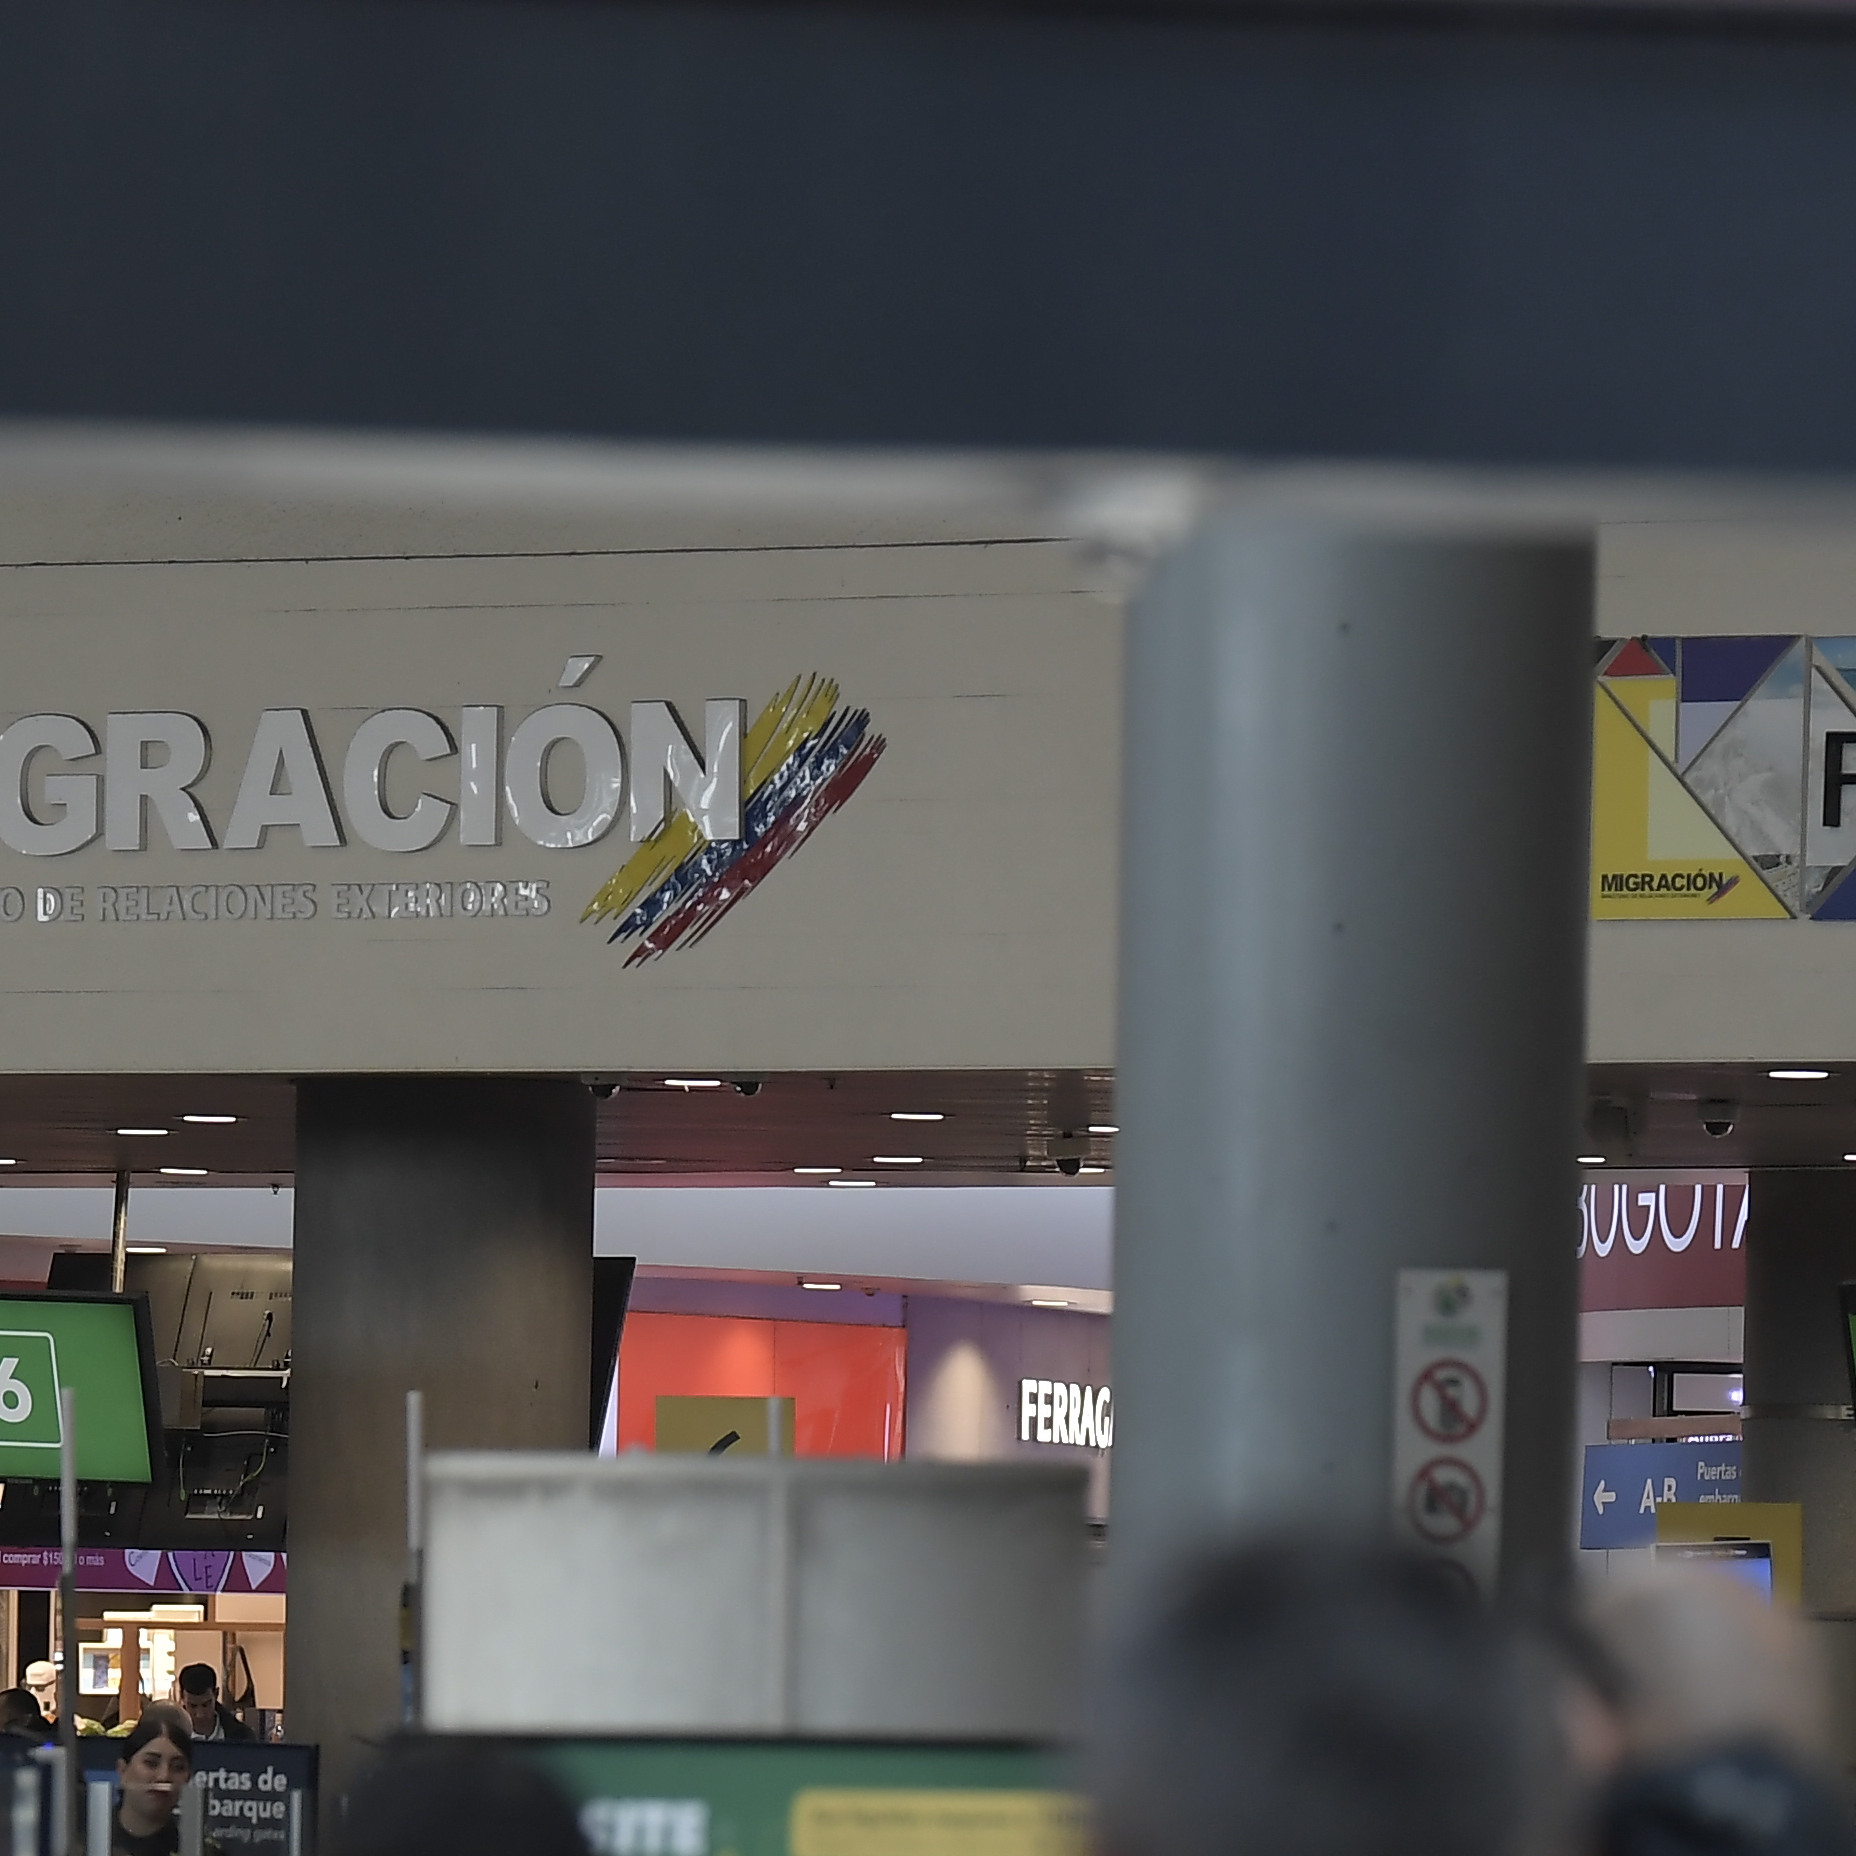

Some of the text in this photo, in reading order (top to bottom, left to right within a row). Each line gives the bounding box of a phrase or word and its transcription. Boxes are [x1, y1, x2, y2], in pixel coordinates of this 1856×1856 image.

[1600, 868, 1724, 893] MIGRACIÓN
[36, 885, 86, 923] DE
[96, 883, 319, 922] RELACIONES
[331, 879, 553, 921] EXTERIORES
[1697, 1461, 1737, 1481] Puertas
[3, 1552, 41, 1567] comprar
[193, 1764, 288, 1793] ertas de
[207, 1790, 287, 1825] barque
